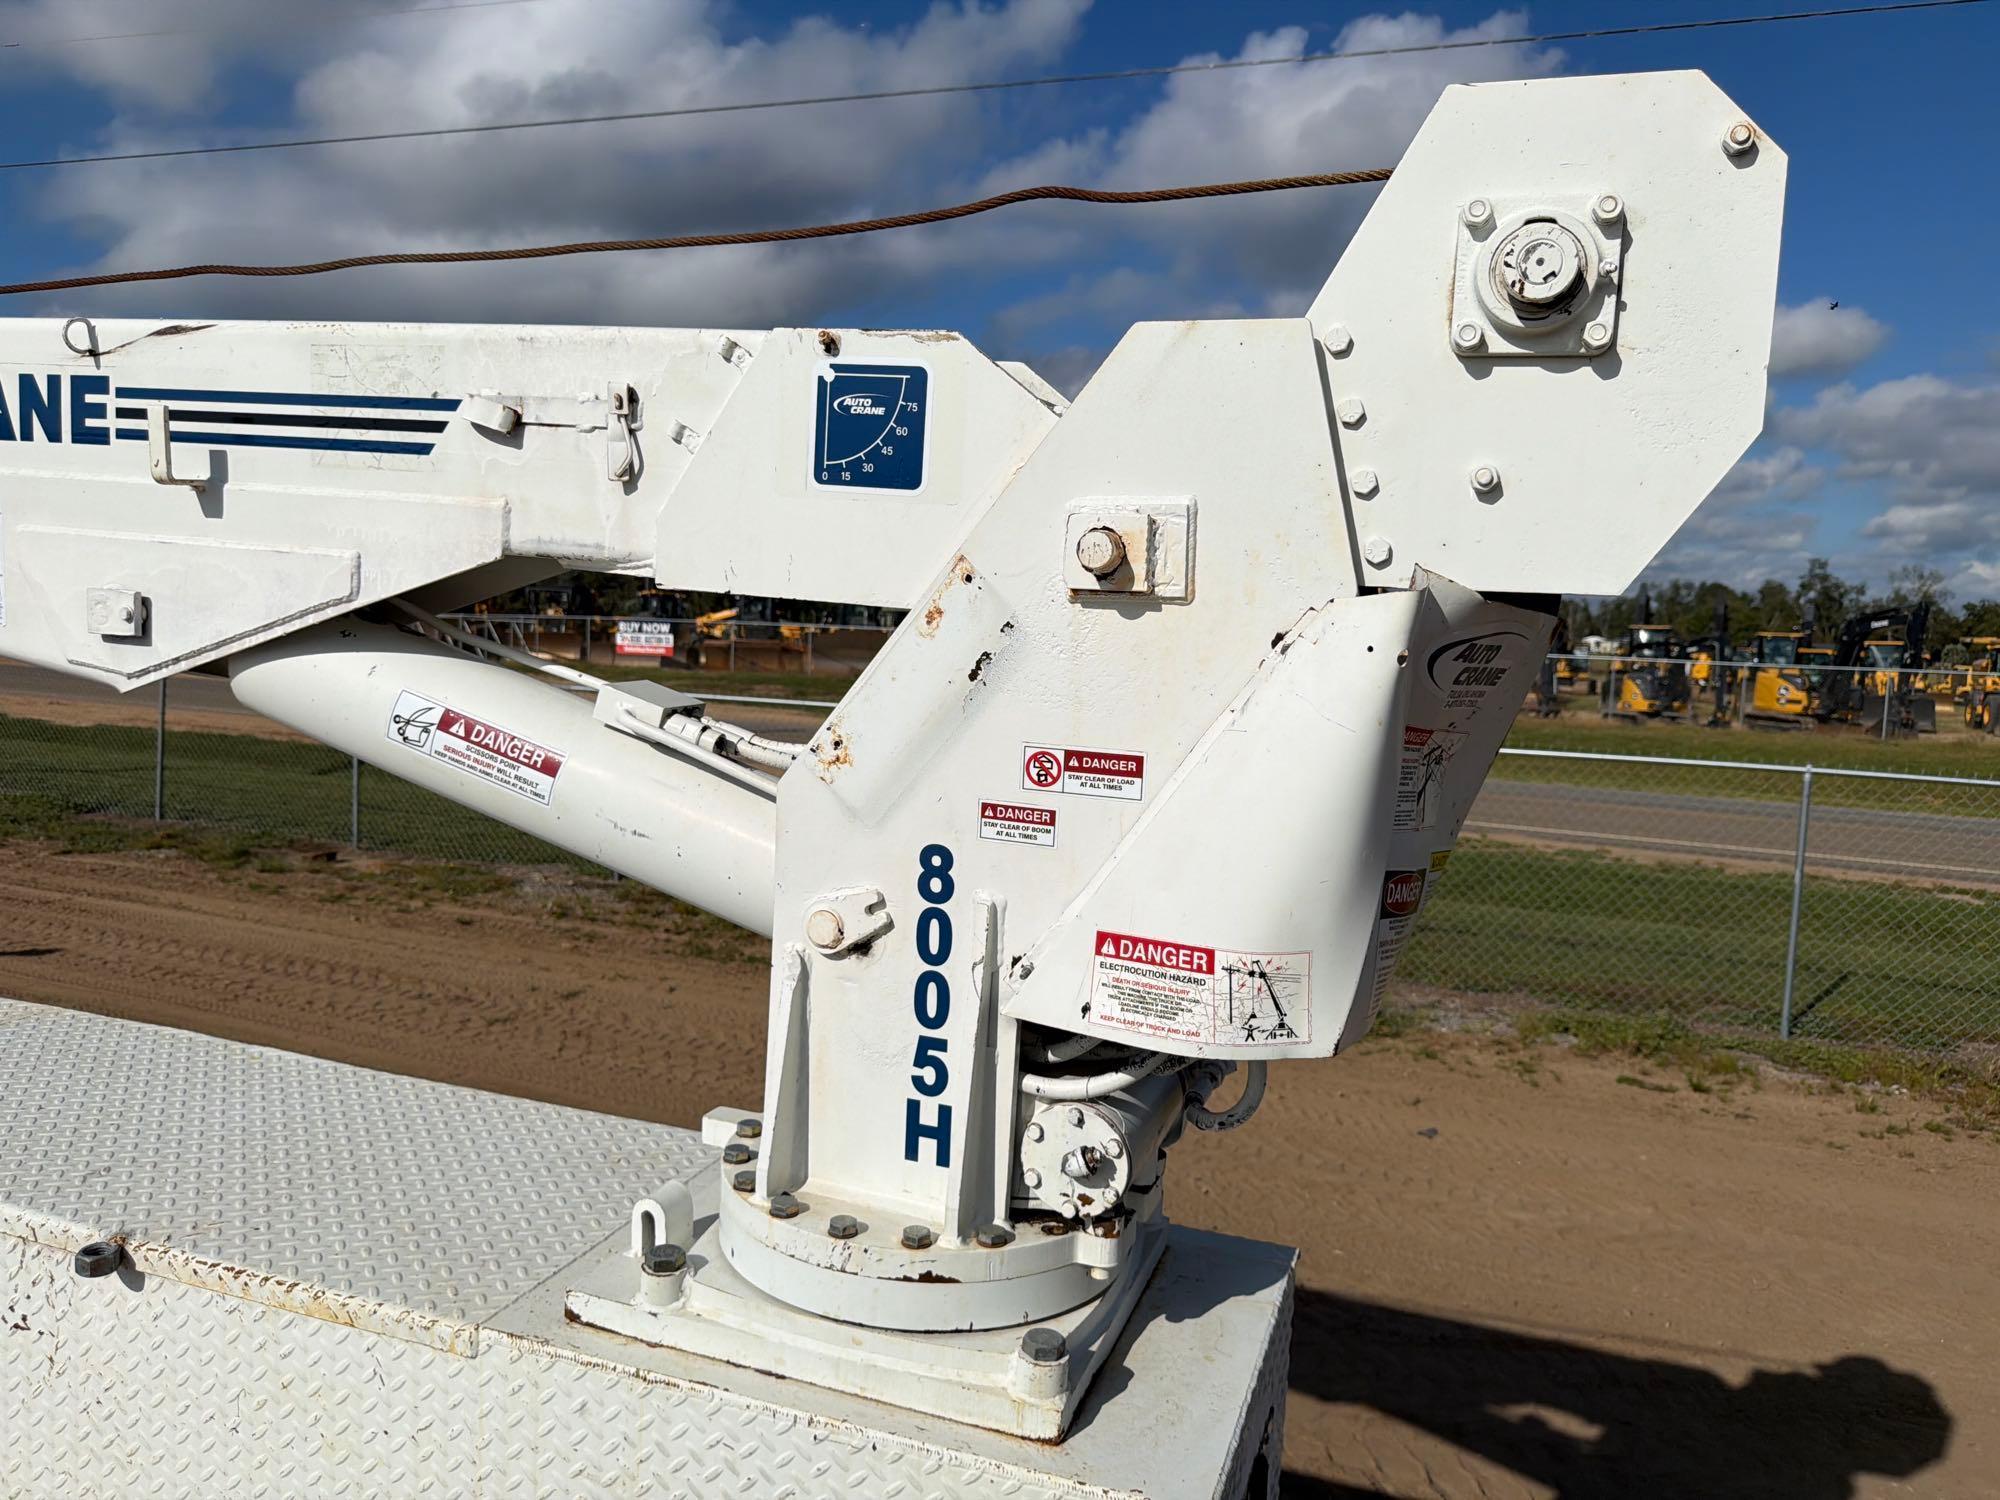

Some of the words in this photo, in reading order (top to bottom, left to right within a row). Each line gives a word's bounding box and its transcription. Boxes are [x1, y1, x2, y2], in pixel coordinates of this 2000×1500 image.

[843, 398, 872, 406] AUTO
[907, 402, 918, 412] 75
[850, 406, 885, 415] CRANE
[896, 427, 908, 436] 60
[881, 446, 893, 455] 45
[862, 463, 874, 472] 30
[822, 471, 828, 480] 0
[841, 471, 851, 480] 15
[618, 621, 640, 633] BUY
[641, 622, 671, 633] NOW
[1452, 642, 1503, 665] AUTO
[1452, 666, 1507, 687] CRANE
[470, 725, 546, 769] DANGER
[465, 744, 499, 763] SCISSORS
[500, 759, 521, 772] POINT
[443, 744, 472, 761] SERIOUS
[472, 757, 497, 771] INJURY
[496, 767, 513, 779] WILL
[514, 774, 540, 789] RESULT
[1082, 757, 1137, 772] DANGER
[434, 749, 447, 759] KEEP
[448, 754, 466, 767] HANDS
[466, 762, 478, 772] AND
[478, 768, 494, 779] ARMS
[494, 774, 511, 785] CLEAR
[518, 784, 529, 793] ALL
[529, 790, 546, 800] TIMES
[1084, 775, 1106, 783] CLEAR
[1116, 778, 1135, 786] LOAD
[1102, 783, 1123, 791] TIMES
[996, 806, 1051, 824] DANGER
[983, 821, 999, 829] STAY
[999, 823, 1021, 831] CLEAR
[1031, 826, 1052, 834] BOOM
[1018, 833, 1038, 841] TIMES
[1119, 939, 1208, 972] DANGER
[1099, 961, 1167, 980] ELECTROCUTION
[1168, 973, 1206, 987] HAZARD
[1112, 976, 1131, 986] DEATH
[1131, 979, 1140, 987] OR
[1140, 981, 1167, 992] SERIOUS
[1167, 986, 1191, 996] INJURY
[1142, 988, 1163, 998] CONTACT
[904, 843, 955, 1168] 8005H
[1118, 1001, 1140, 1010] LOADLINE
[1122, 996, 1155, 1007] ATTACHMENTS
[1159, 997, 1175, 1005] TRUCK
[1099, 1014, 1115, 1022] KEEP
[1115, 1017, 1135, 1026] CLEAR
[1145, 1022, 1168, 1032] TRUCK
[1167, 1027, 1181, 1035] AND
[1181, 1030, 1201, 1038] LOAD
